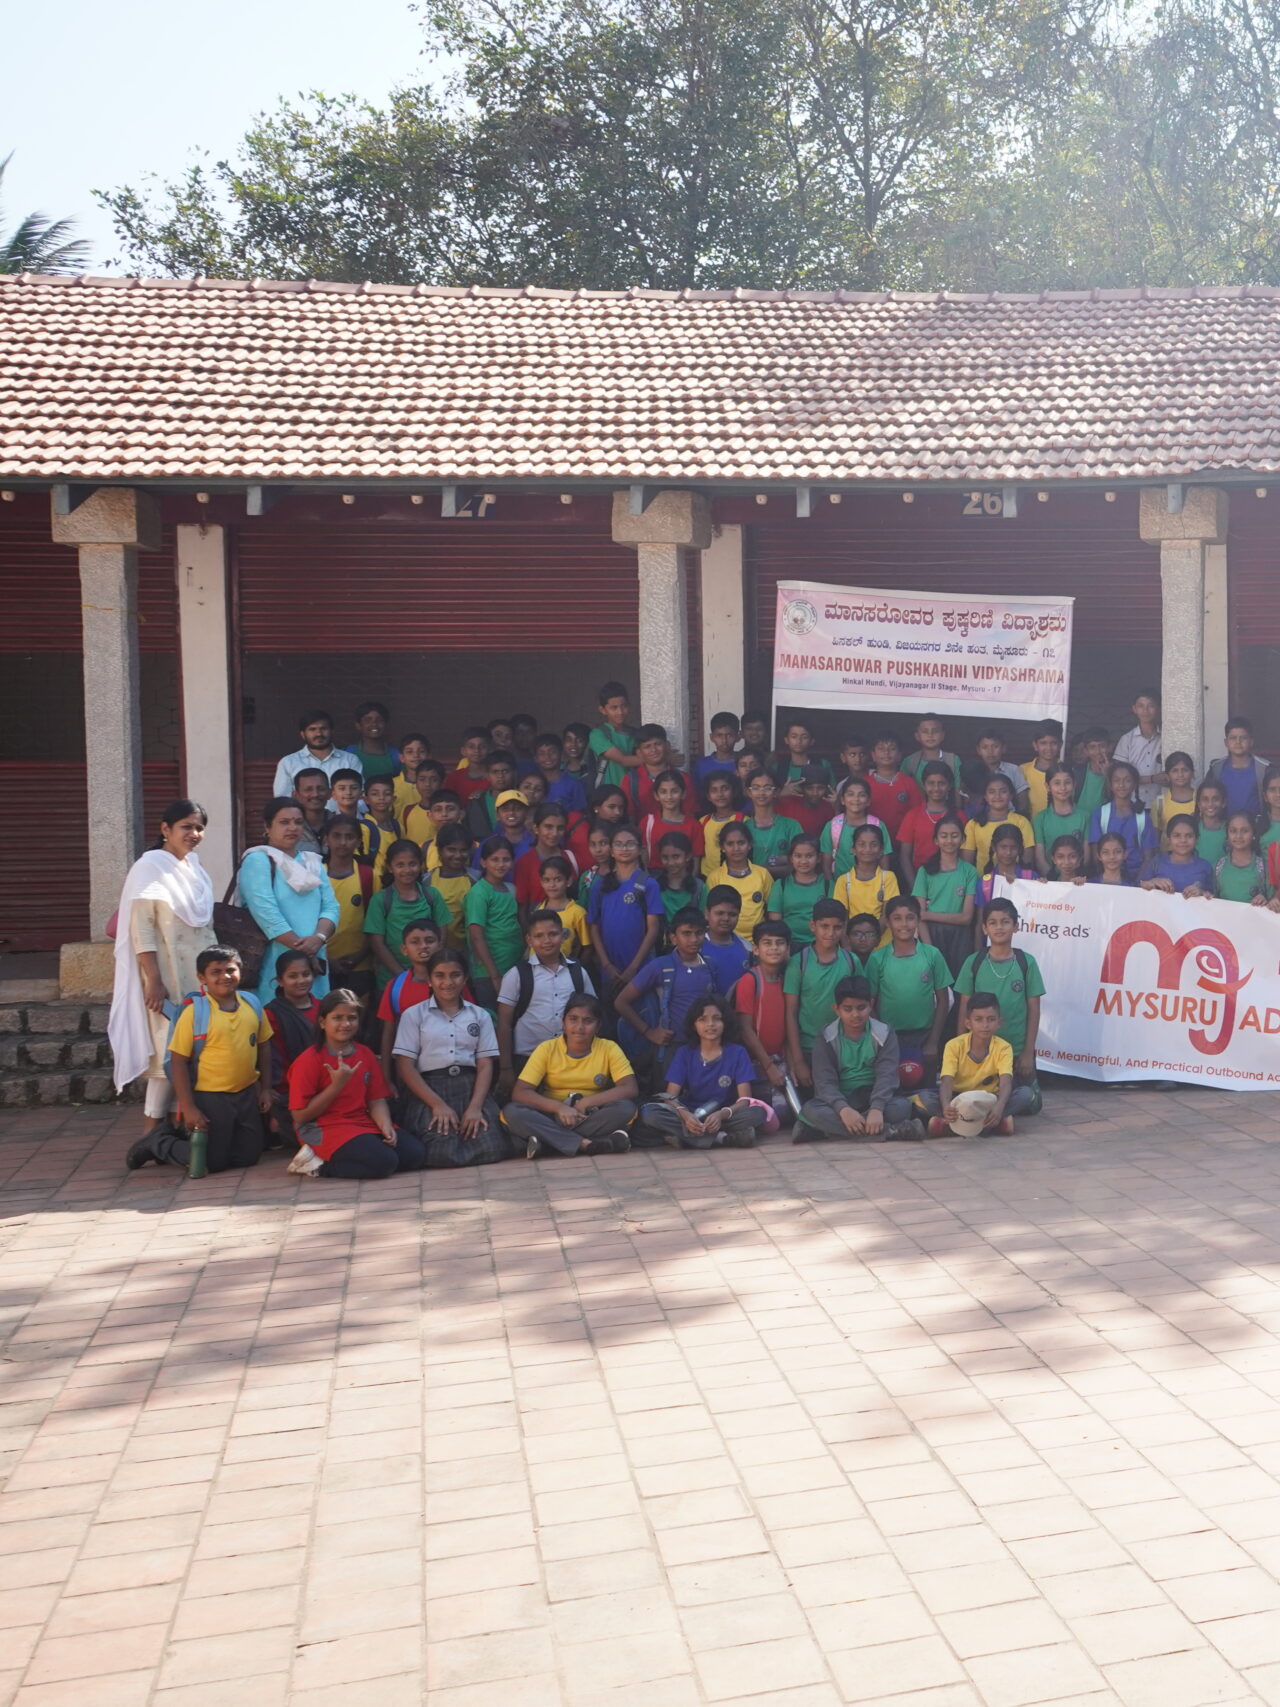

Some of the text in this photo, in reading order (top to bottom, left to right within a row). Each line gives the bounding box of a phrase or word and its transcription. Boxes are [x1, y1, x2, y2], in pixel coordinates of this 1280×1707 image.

[962, 492, 1003, 515] 26
[824, 602, 934, 626] ಮಾನಸರೋವರ
[779, 653, 1065, 684] MANASAROWAR PUSHKARINI VIDYASHRAMA
[842, 677, 864, 685] Hinkal
[961, 684, 986, 692] Mysuru
[1026, 900, 1076, 914] Powered By
[1018, 915, 1090, 940] hirag ads
[1093, 988, 1218, 1026] MYSURU
[1057, 1050, 1122, 1067] Meaningful,
[1125, 1058, 1149, 1069] And
[1151, 1060, 1203, 1074] Practical
[1206, 1066, 1263, 1081] Outbound
